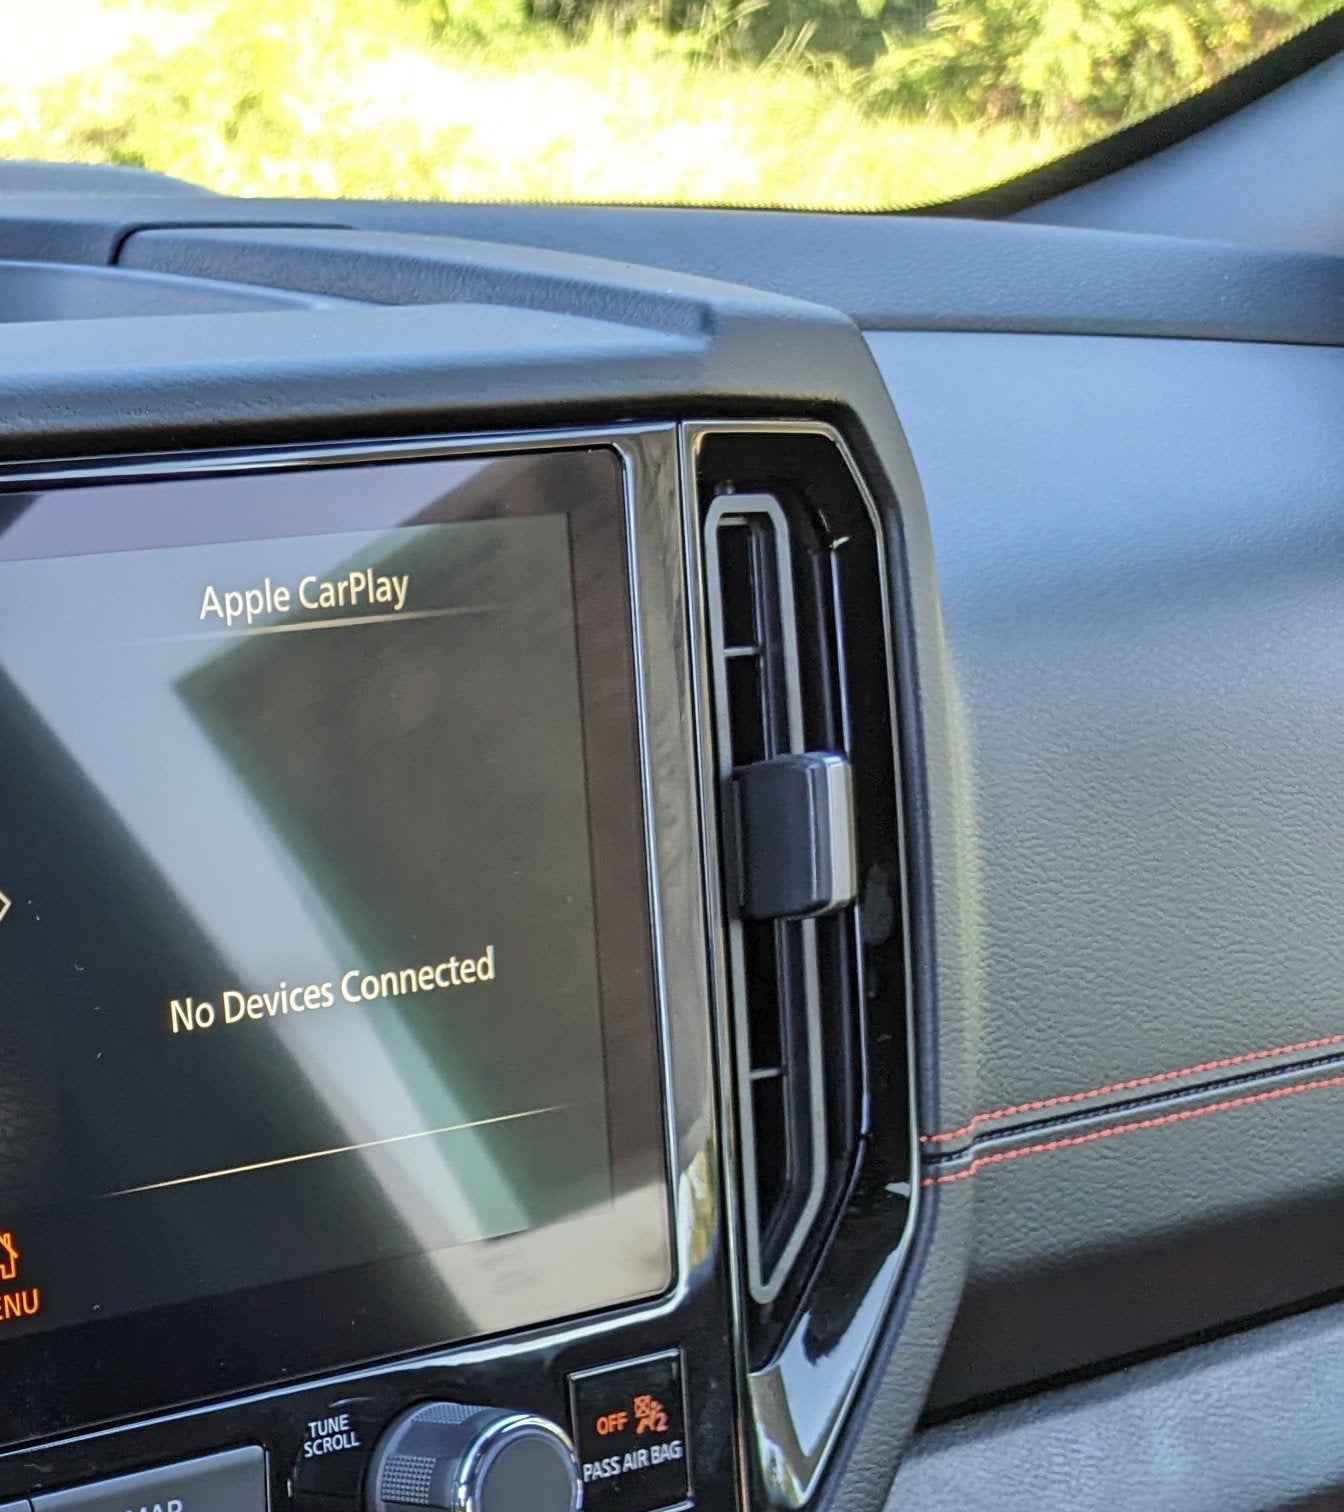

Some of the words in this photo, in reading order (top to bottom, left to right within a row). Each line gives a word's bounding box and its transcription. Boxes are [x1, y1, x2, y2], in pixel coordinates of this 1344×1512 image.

[199, 578, 290, 626] Apple
[298, 568, 410, 610] CarPlay
[170, 998, 214, 1033] No
[223, 980, 334, 1025] Devices
[341, 945, 497, 1002] Connected
[308, 1414, 350, 1439] TUNE
[596, 1411, 629, 1435] OFF
[303, 1431, 361, 1459] SCROLL
[582, 1456, 621, 1483] PASS
[622, 1448, 650, 1473] AIR
[650, 1440, 685, 1464] BAG
